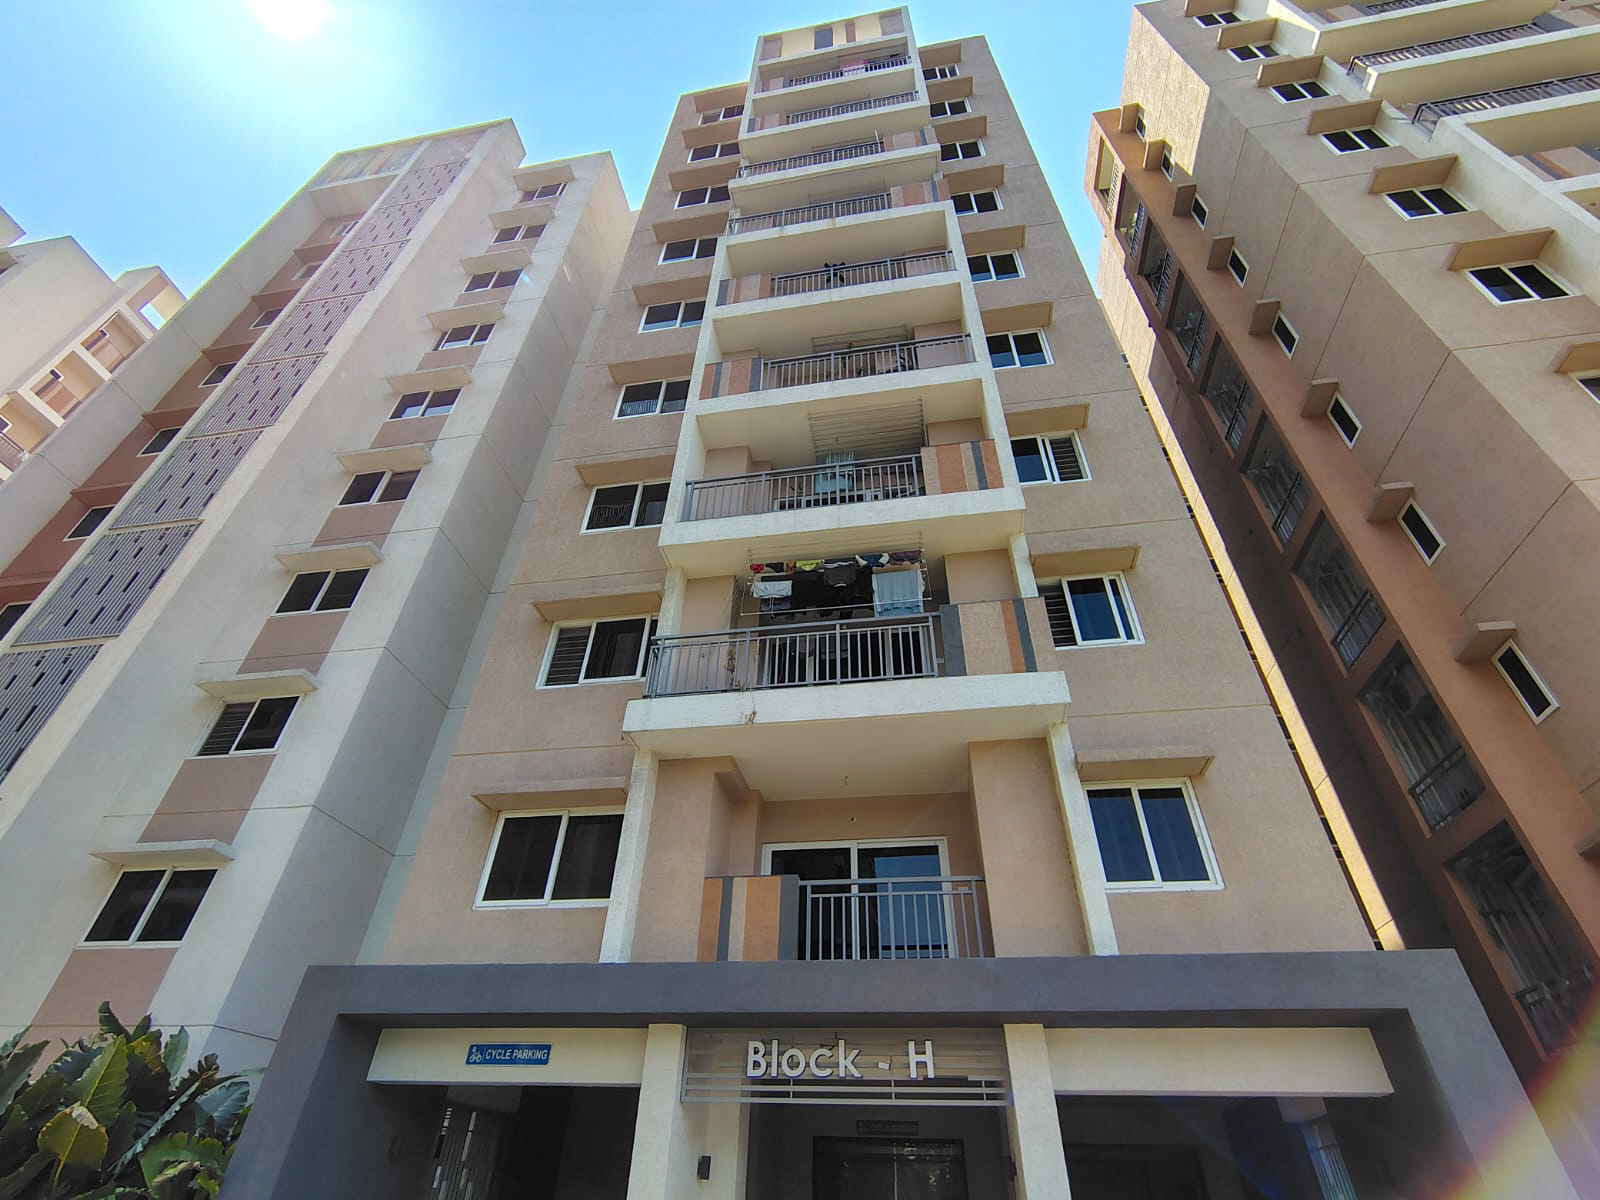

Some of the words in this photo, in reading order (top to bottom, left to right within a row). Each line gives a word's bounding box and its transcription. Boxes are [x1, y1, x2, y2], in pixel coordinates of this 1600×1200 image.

[485, 1049, 511, 1059] CYCLE
[512, 1049, 548, 1059] PARKING
[746, 1039, 863, 1078] Block
[908, 1039, 935, 1078] H
